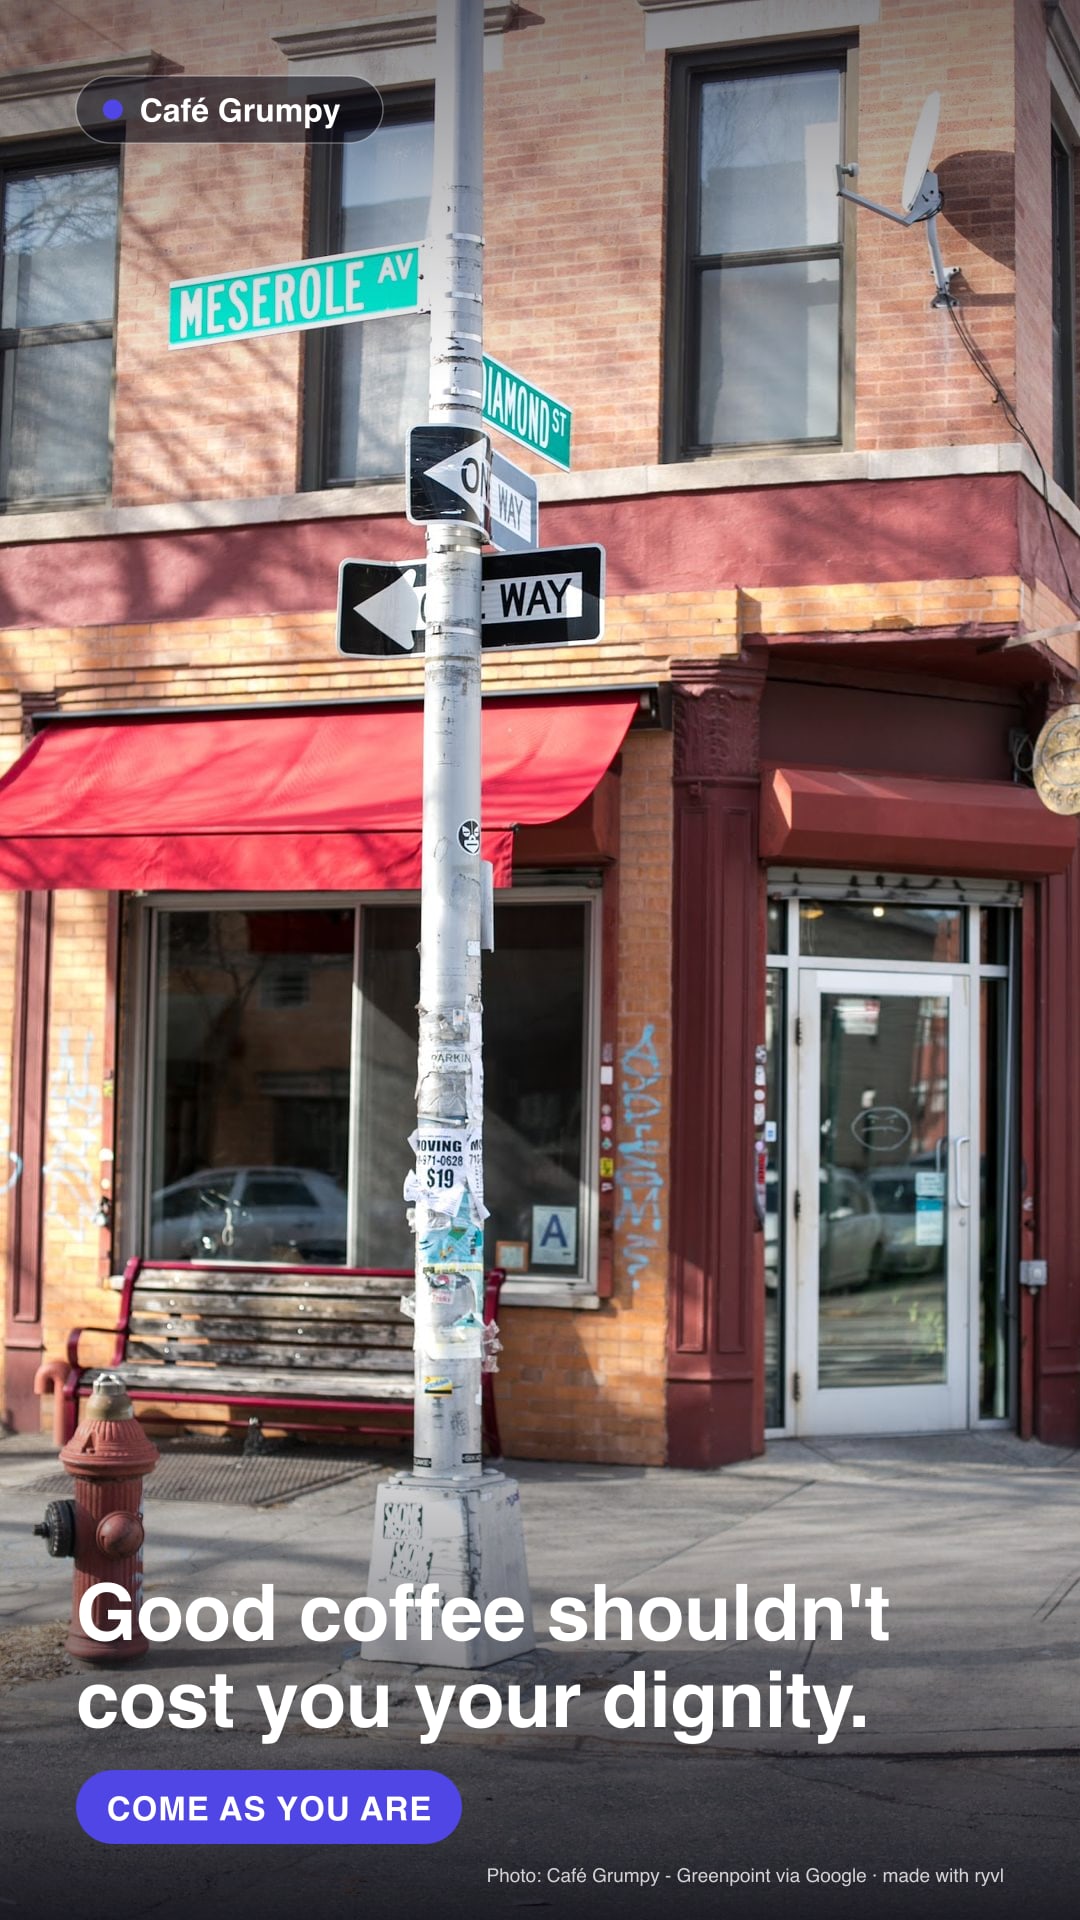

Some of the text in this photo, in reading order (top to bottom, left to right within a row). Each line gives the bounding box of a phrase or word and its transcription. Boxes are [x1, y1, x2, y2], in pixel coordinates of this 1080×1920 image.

[179, 253, 413, 339] MESEROLE AV
[552, 408, 567, 437] ST
[461, 457, 524, 531] ON WAY
[500, 577, 572, 618] WAY
[427, 1168, 454, 1189] $19
[540, 1214, 568, 1248] A
